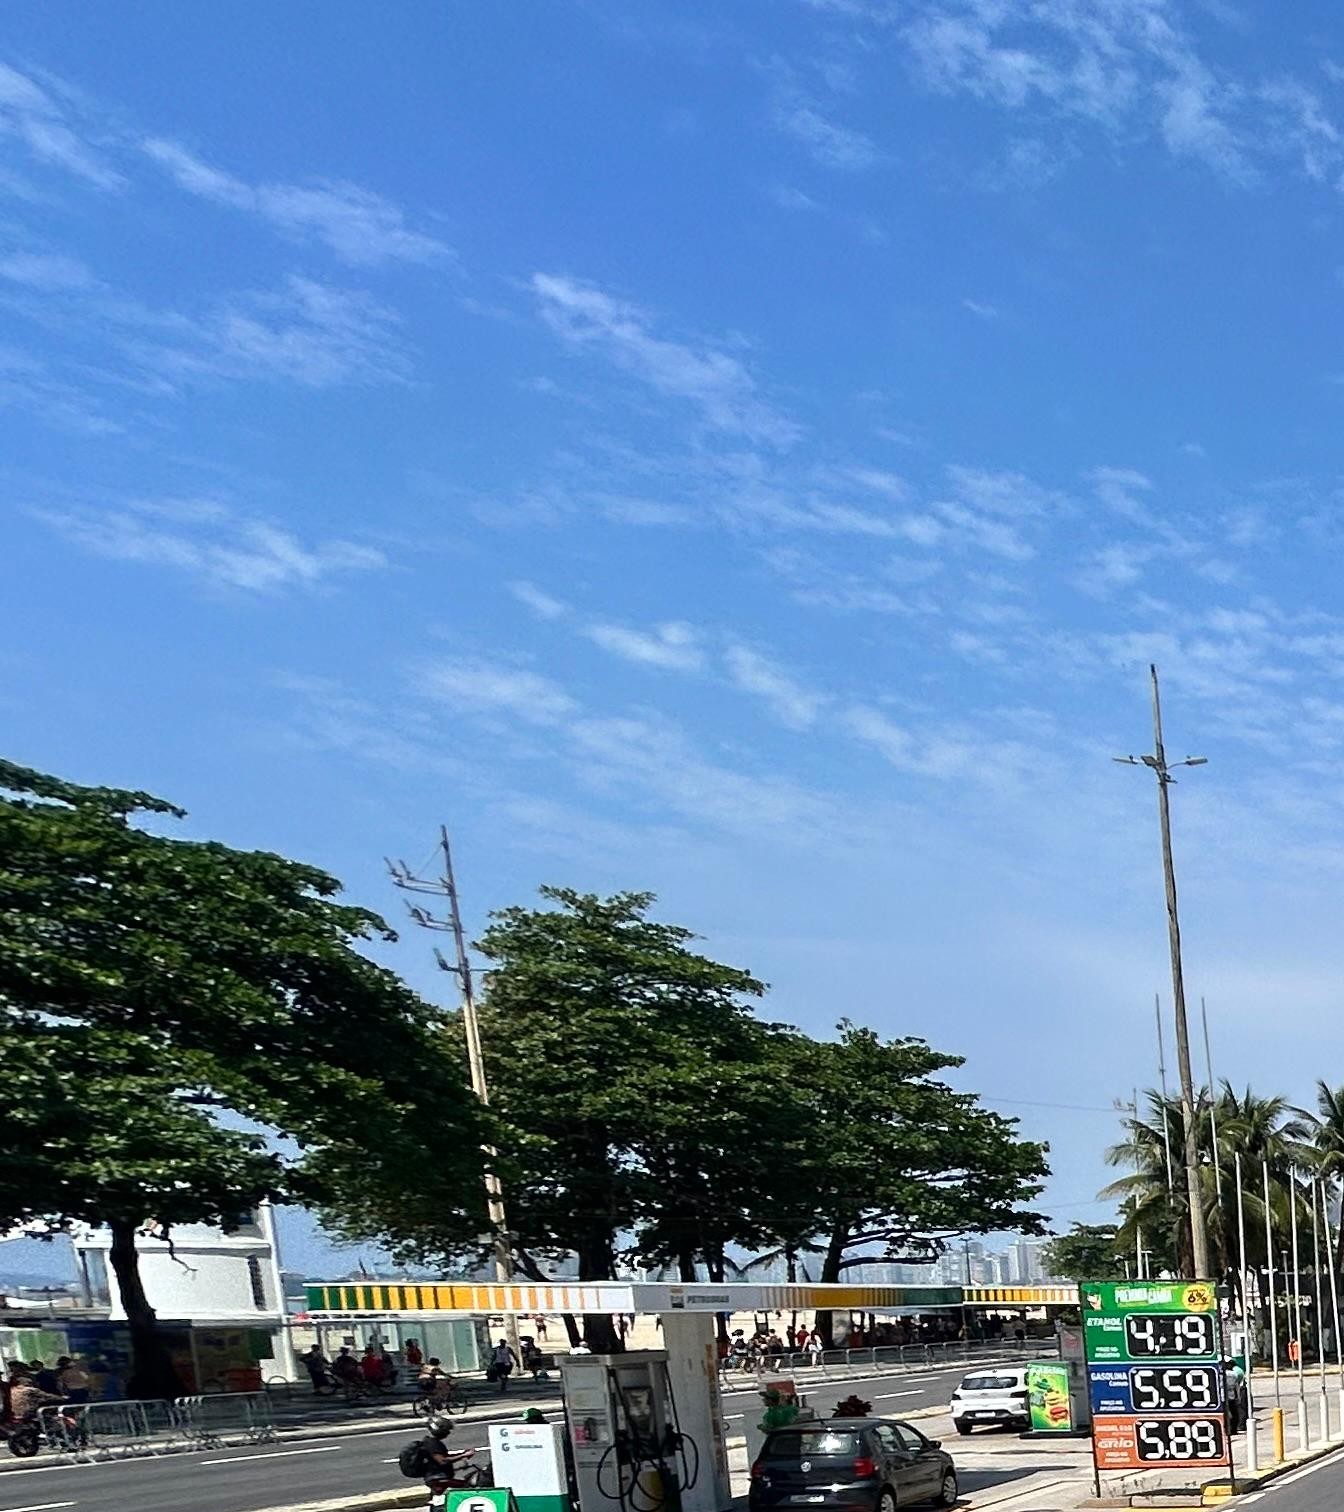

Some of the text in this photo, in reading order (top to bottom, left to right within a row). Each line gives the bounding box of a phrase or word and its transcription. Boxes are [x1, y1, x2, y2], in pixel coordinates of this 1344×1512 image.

[1087, 1317, 1122, 1327] ETANOL
[1090, 1371, 1129, 1382] GASOLINA
[1134, 1369, 1211, 1408] 5,59
[1139, 1420, 1217, 1460] 5,89
[501, 1442, 511, 1453] G
